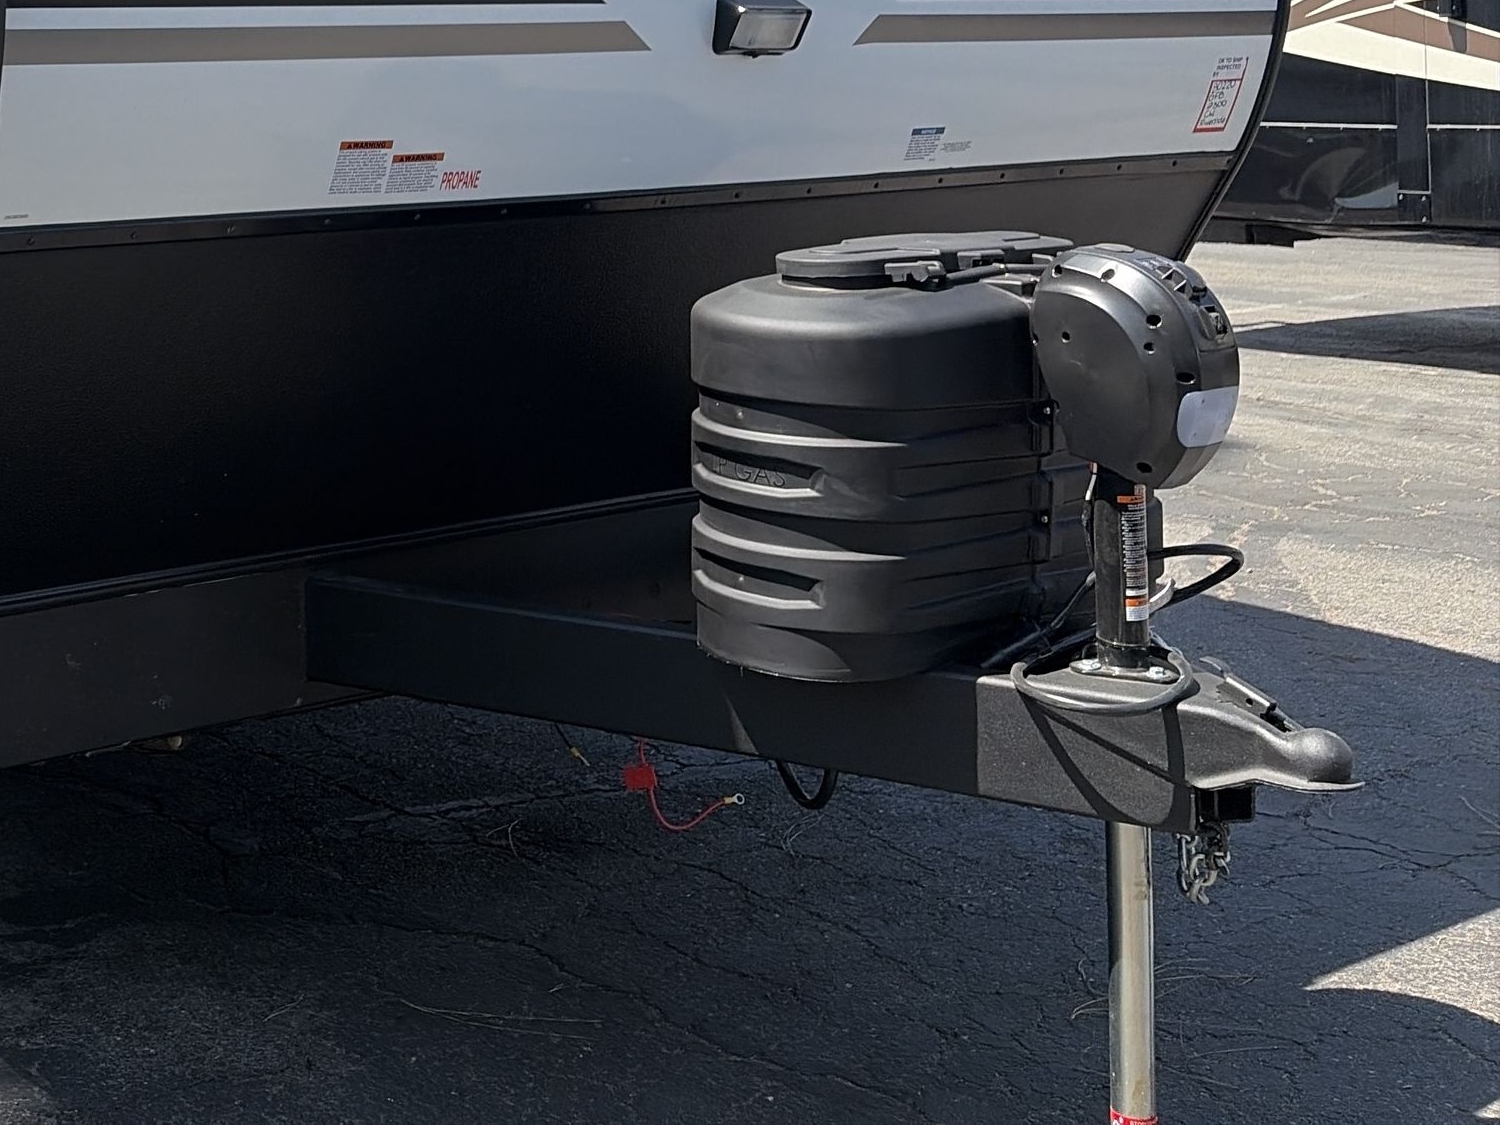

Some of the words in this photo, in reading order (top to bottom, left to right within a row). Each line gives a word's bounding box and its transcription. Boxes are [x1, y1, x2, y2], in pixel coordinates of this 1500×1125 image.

[353, 140, 386, 149] WARNING
[405, 153, 437, 162] WARNING
[440, 170, 482, 191] PROPANE
[734, 462, 786, 488] GAS
